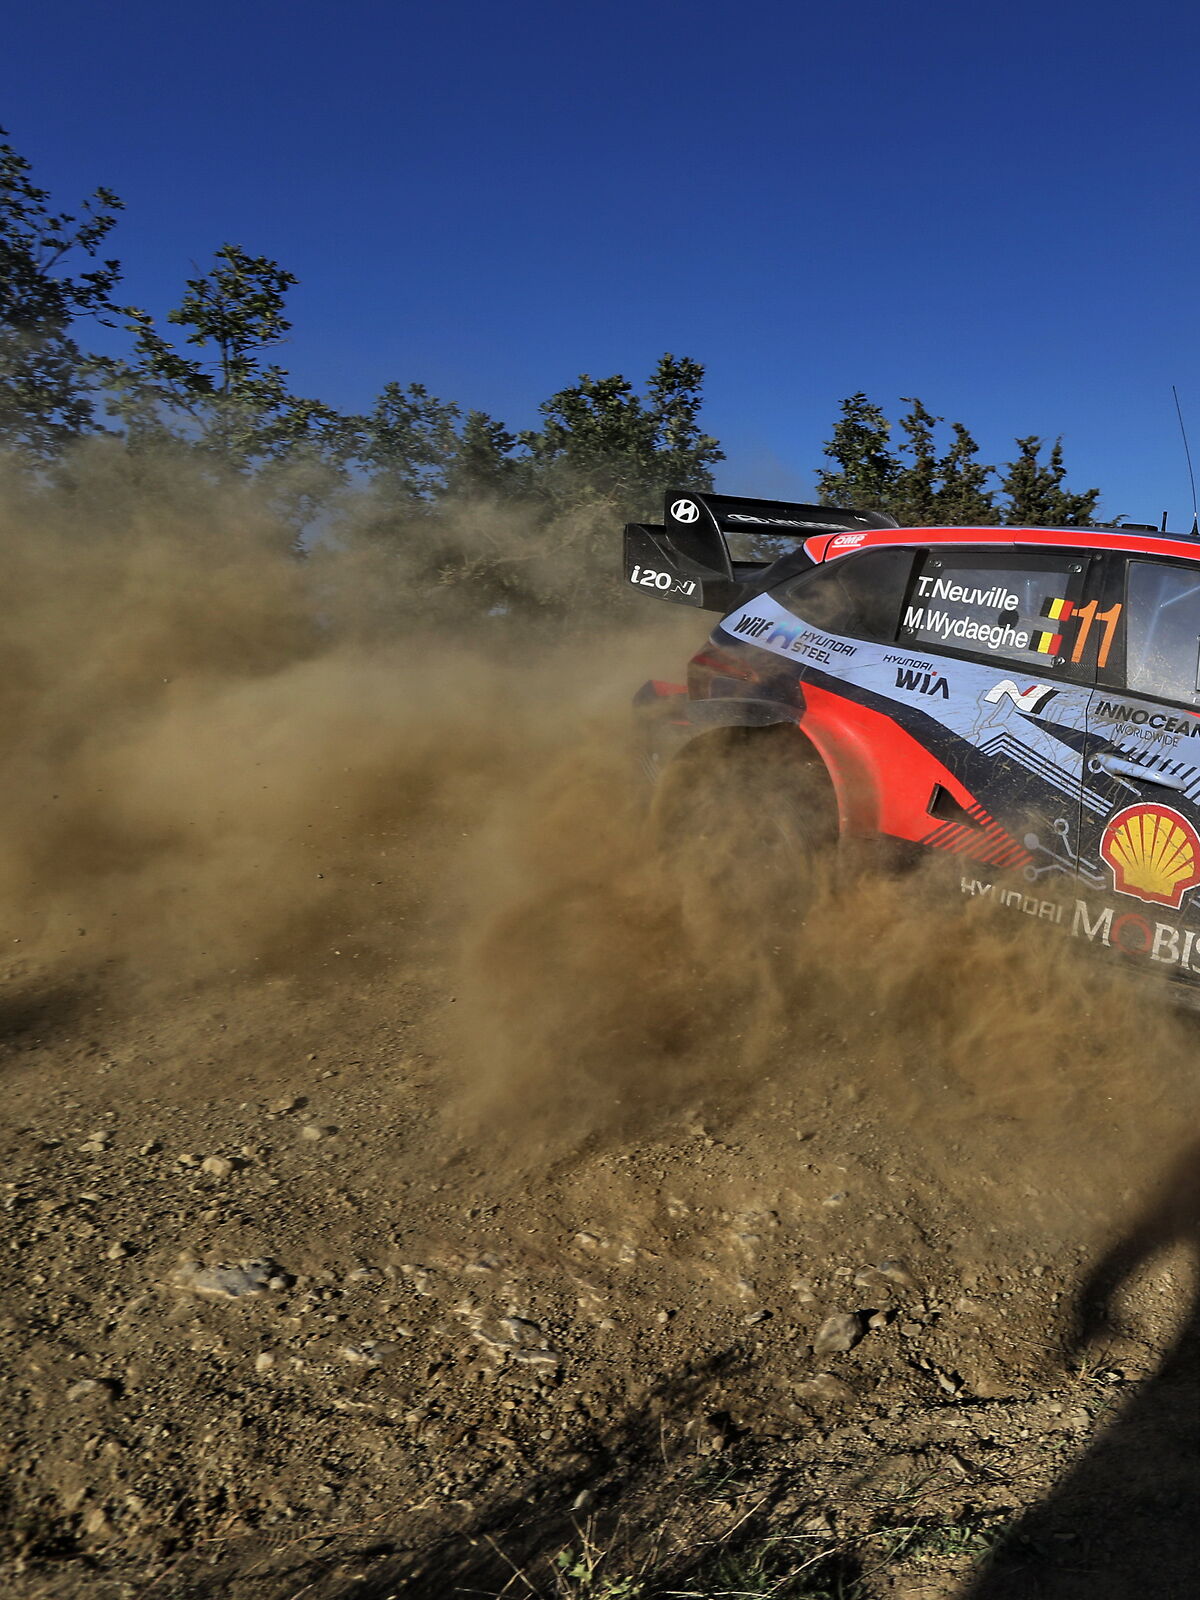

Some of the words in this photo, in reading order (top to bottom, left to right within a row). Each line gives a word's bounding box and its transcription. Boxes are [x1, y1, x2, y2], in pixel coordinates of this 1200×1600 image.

[833, 535, 866, 545] OMP
[630, 565, 672, 590] i20
[917, 576, 1019, 611] T.Neuville
[733, 613, 775, 639] Wilf
[902, 606, 1029, 649] M.Wydaeghe
[1071, 600, 1123, 668] 11
[790, 642, 831, 665] STEEL
[800, 630, 858, 658] HYUNDAI
[882, 654, 934, 671] HYUNDAI
[1115, 722, 1180, 748] WORLDWIDE
